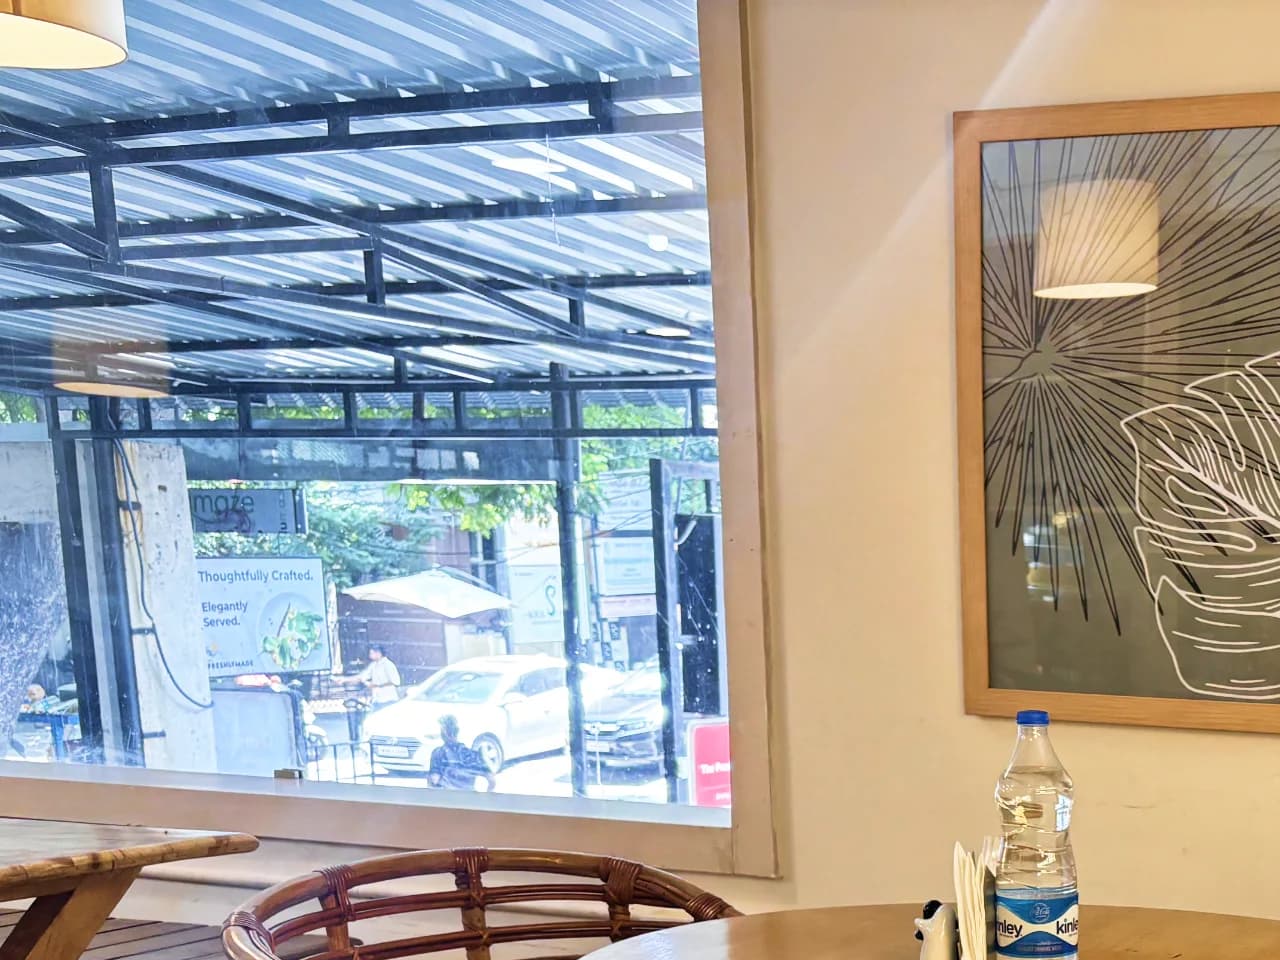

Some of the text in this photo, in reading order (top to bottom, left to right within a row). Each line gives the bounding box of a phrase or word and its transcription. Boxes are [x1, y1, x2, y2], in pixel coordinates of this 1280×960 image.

[198, 569, 314, 583] Thoughtfully Crafted.
[201, 600, 248, 614] Elegantly
[203, 615, 241, 628] Served.
